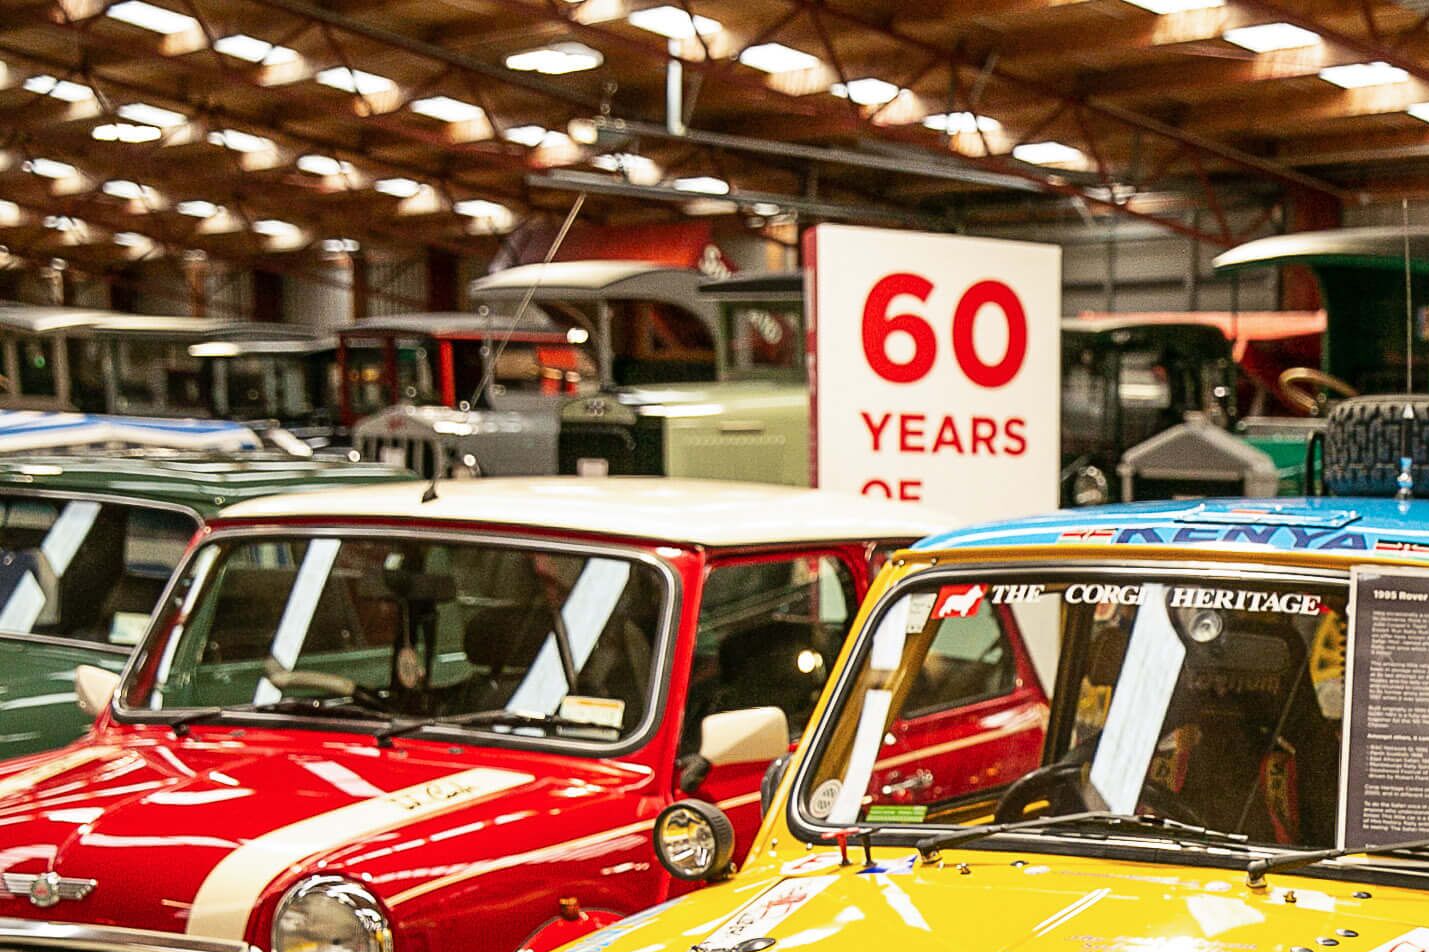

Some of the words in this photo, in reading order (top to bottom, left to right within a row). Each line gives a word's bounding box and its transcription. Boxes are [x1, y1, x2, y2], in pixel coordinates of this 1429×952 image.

[862, 272, 1028, 388] 60
[861, 412, 1028, 456] YEARS
[1115, 525, 1368, 550] KENYA
[991, 583, 1046, 604] THE
[1065, 583, 1147, 605] CORGI
[1170, 587, 1322, 616] HERITAGE
[1399, 591, 1428, 601] Rover
